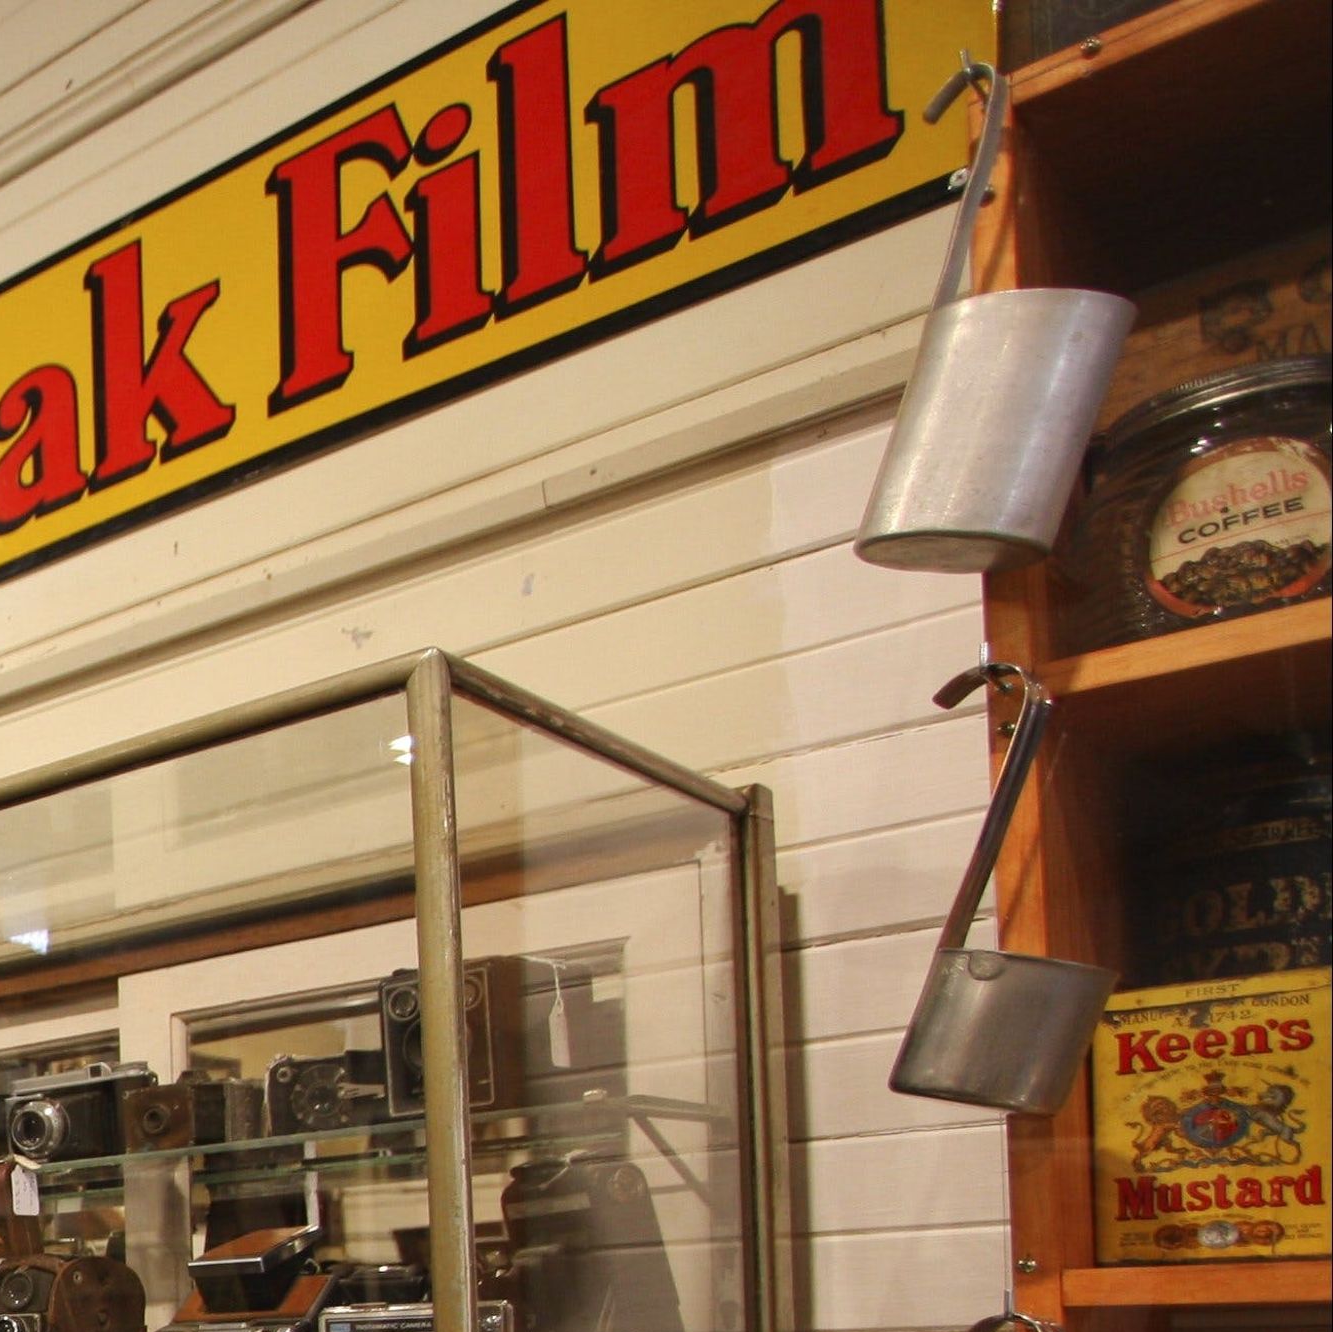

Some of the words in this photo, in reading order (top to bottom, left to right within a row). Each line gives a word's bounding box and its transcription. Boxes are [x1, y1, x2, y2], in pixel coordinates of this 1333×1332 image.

[266, 0, 906, 418] Film
[1166, 468, 1310, 529] Bushells
[1178, 496, 1305, 545] COFFEE
[1185, 983, 1240, 998] FIRST
[1114, 1018, 1314, 1076] Keen's
[1113, 1164, 1326, 1222] Mustard
